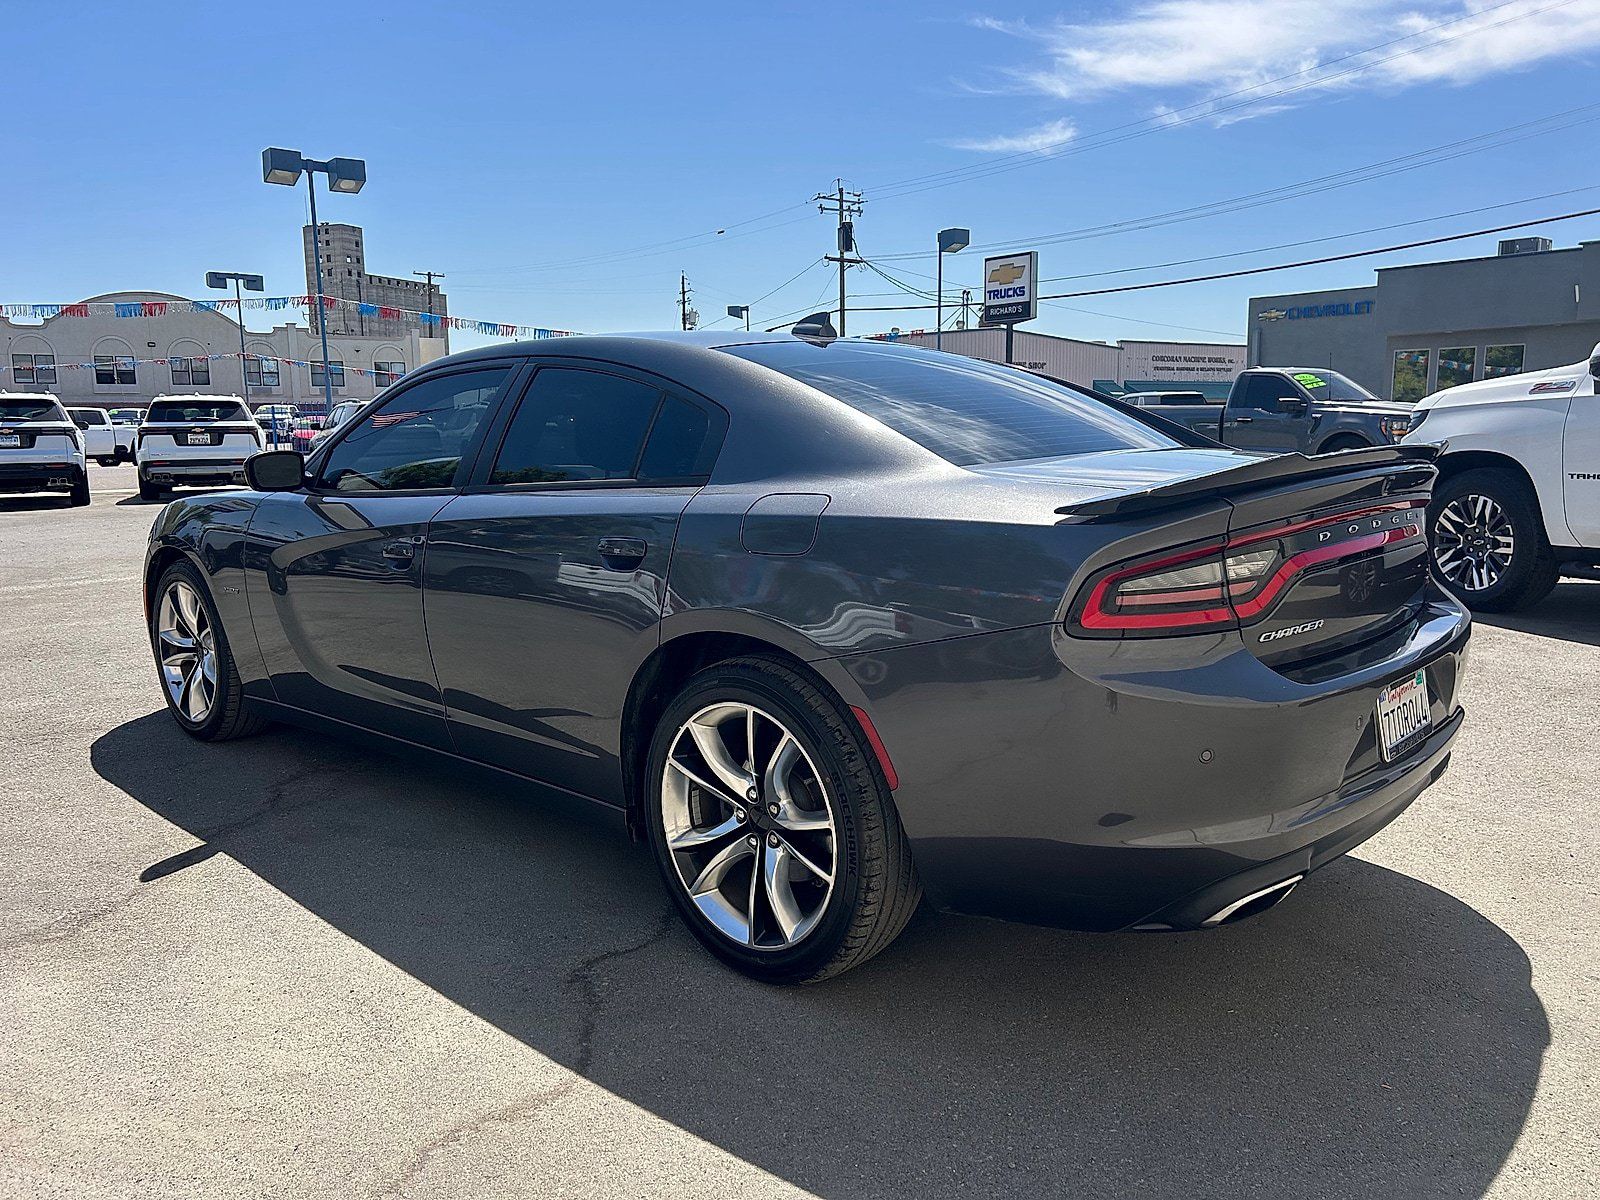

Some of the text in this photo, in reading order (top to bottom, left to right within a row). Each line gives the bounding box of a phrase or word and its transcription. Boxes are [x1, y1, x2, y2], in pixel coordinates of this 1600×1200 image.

[987, 285, 1026, 301] TRUCKS
[989, 305, 1023, 316] RICHARD'S
[1288, 300, 1375, 320] CHEVROLET
[1319, 512, 1413, 542] DODGE
[1259, 619, 1325, 643] CHARGER
